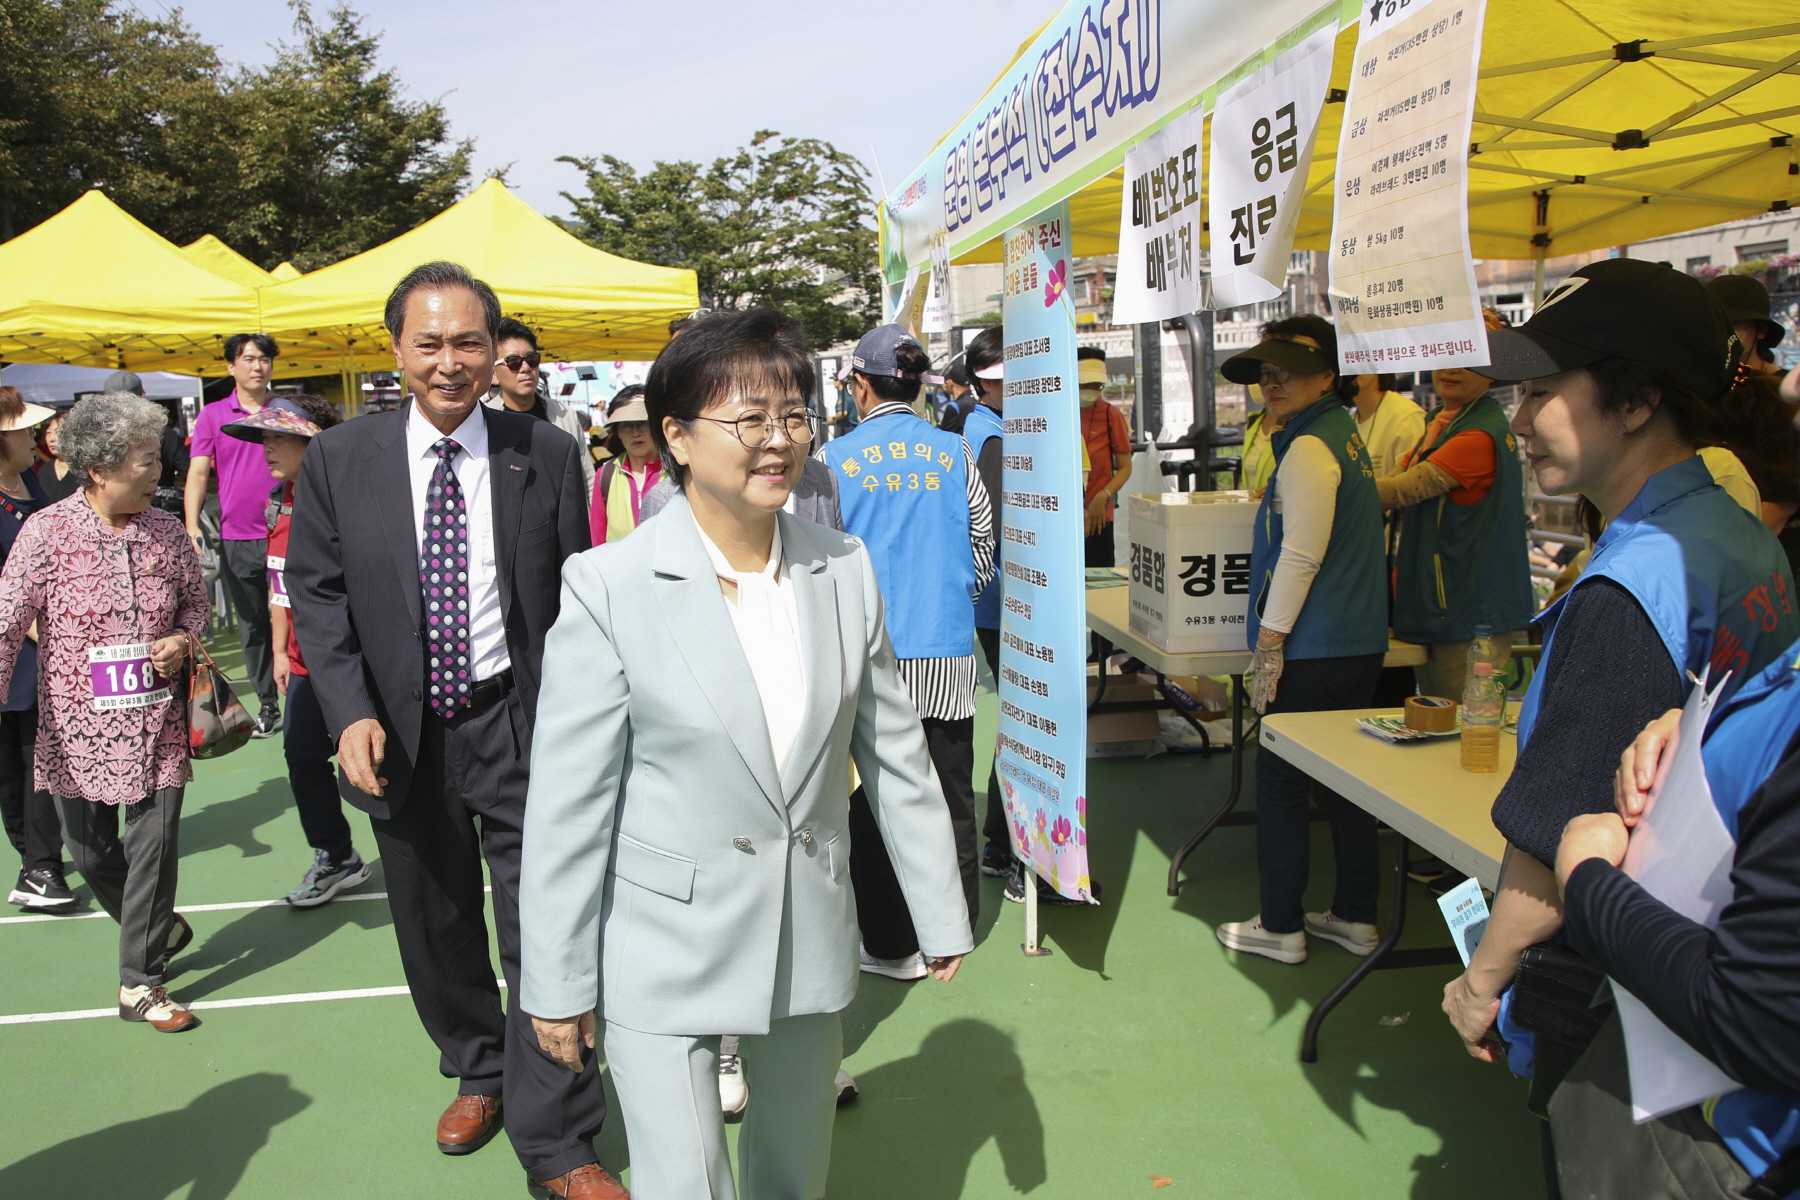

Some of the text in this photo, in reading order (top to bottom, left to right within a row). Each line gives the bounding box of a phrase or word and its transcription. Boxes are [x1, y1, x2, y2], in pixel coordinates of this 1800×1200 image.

[1452, 9, 1463, 26] 1명
[1361, 56, 1378, 78] 대상
[1440, 79, 1451, 95] 1명
[1351, 117, 1367, 139] 금상
[944, 132, 972, 232] 운영
[973, 73, 1032, 213] 본부석
[1251, 101, 1298, 183] 응급
[1434, 134, 1448, 150] 5명
[1133, 143, 1198, 229] 배번호표
[1345, 176, 1361, 197] 은상
[1370, 159, 1447, 196] 라라브레드 3만원권 10명
[1010, 228, 1035, 264] 협찬하여
[1039, 218, 1061, 251] 주신
[1341, 237, 1357, 256] 동상
[1367, 226, 1404, 248] 쌀 5kg 10명
[1146, 221, 1192, 292] 배부처
[1005, 262, 1037, 297] 고마운 분들
[1387, 278, 1404, 293] 20명
[1338, 296, 1359, 314] 아차상
[1367, 295, 1444, 319] 문화상품권(1만원) 10명
[1033, 336, 1050, 354] 조서영
[1344, 339, 1476, 363] 협찬해주신 분께 진심으로 감사드립니다.
[1041, 375, 1061, 393] 장민호
[841, 441, 954, 478] 통장협의회
[1012, 456, 1020, 470] 대표
[862, 471, 941, 492] 수유3동
[1031, 494, 1040, 509] 대표
[1130, 542, 1165, 595] 경품함
[1185, 616, 1216, 626] 수유3동
[1024, 641, 1034, 657] 대표
[1035, 645, 1054, 663] 노용범
[106, 661, 154, 692] 168
[1020, 674, 1030, 690] 대표
[119, 697, 142, 706] 수유3동
[1027, 712, 1038, 729] 대표
[1039, 717, 1057, 737] 이동현
